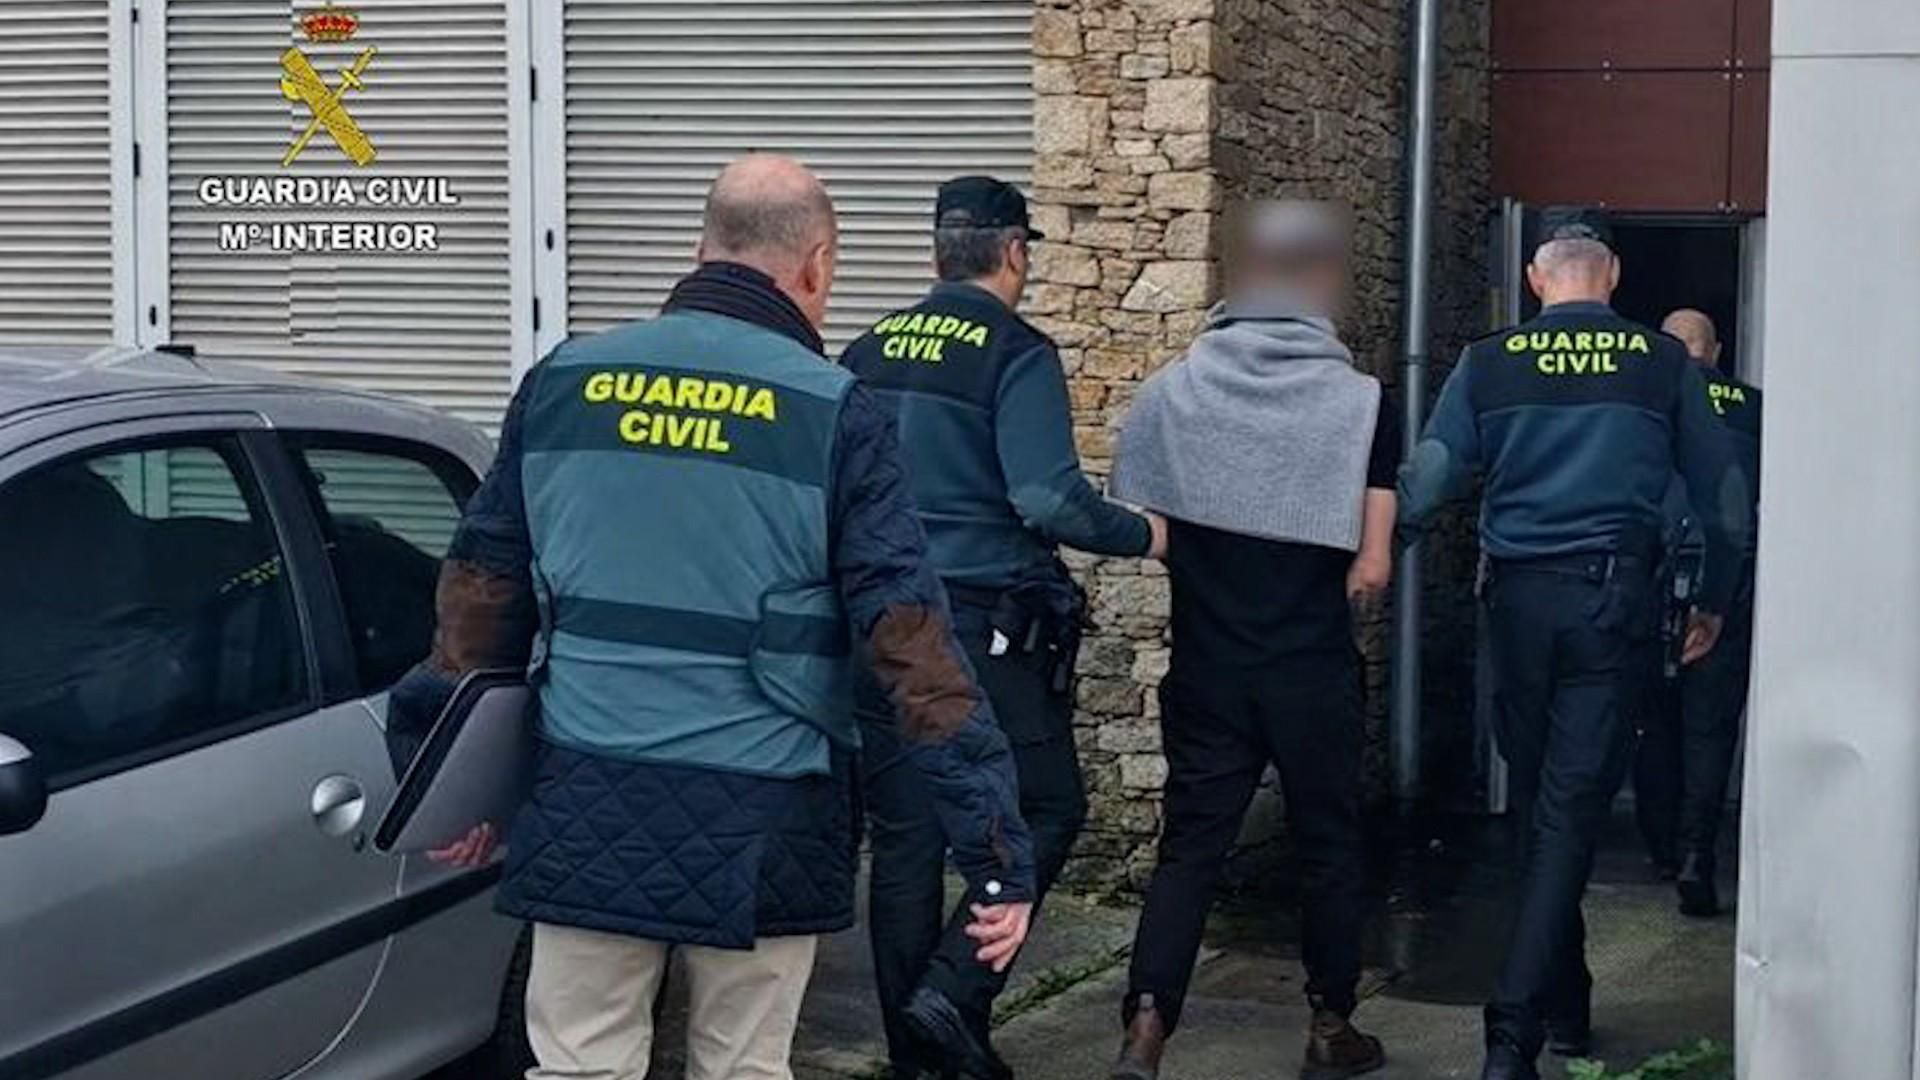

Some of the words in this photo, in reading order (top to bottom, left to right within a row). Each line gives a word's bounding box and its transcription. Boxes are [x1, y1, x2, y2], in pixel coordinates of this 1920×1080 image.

[882, 334, 945, 362] CIVIL
[1505, 331, 1649, 354] GUARDIA
[1537, 352, 1618, 374] CIVIL
[583, 371, 776, 421] GUARDIA
[618, 410, 730, 453] CIVIL
